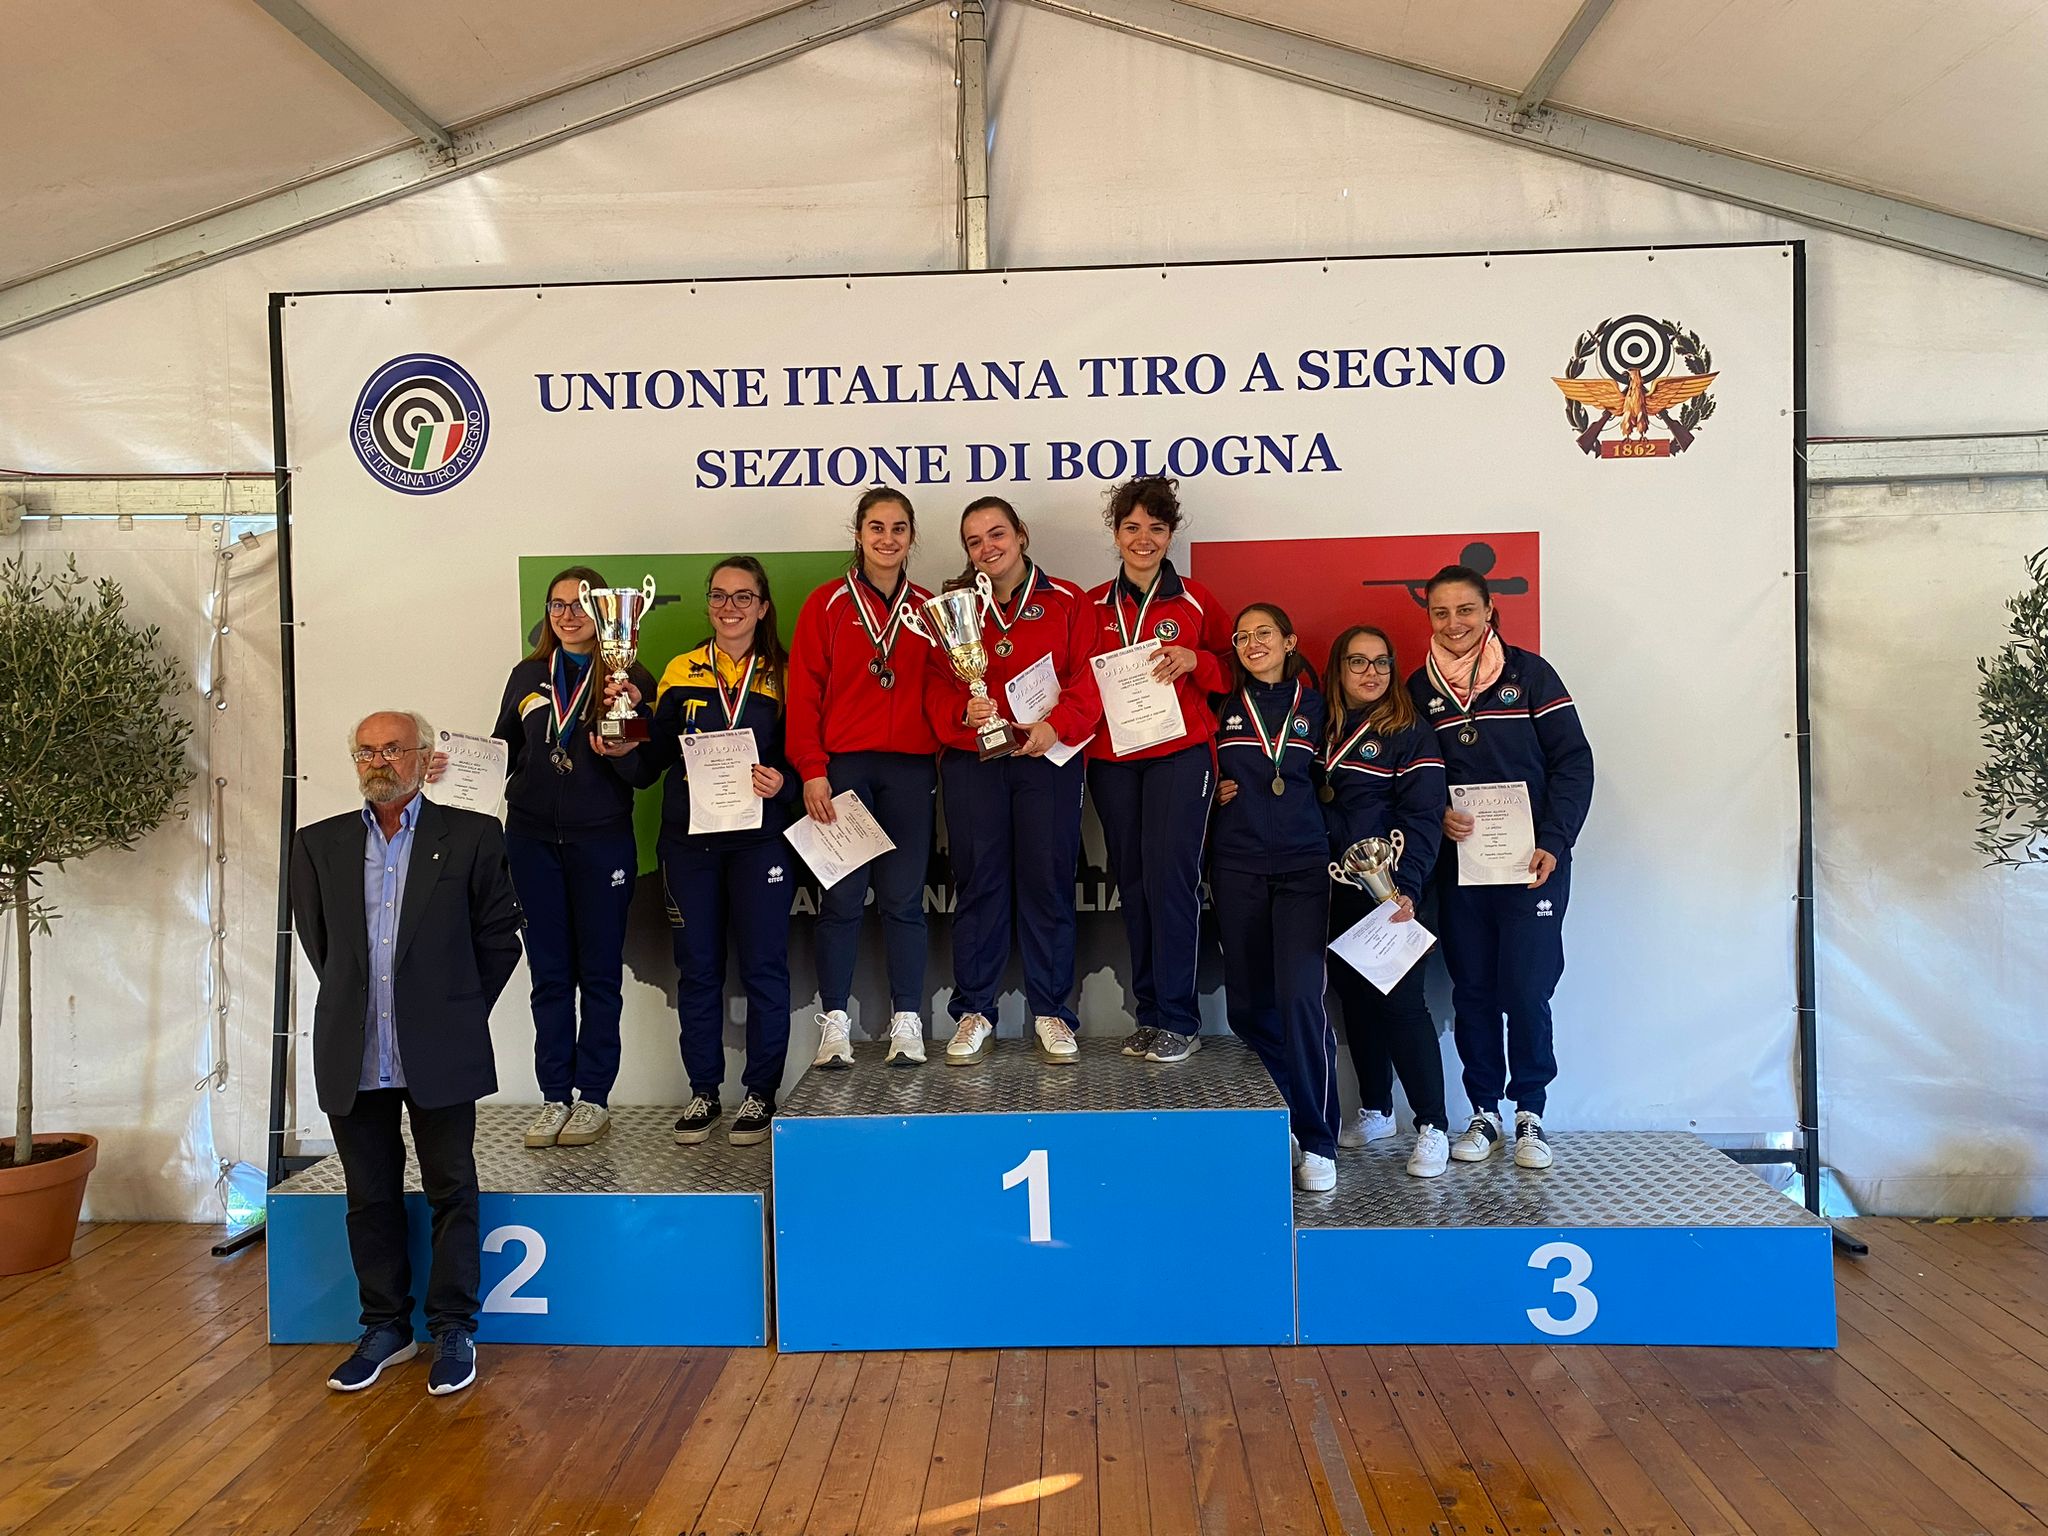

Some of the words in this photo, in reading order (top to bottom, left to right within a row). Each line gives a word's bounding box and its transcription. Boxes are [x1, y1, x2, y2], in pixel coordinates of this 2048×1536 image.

[534, 369, 767, 412] UNIONE
[783, 359, 1068, 405] ITALIANA
[1080, 354, 1225, 397] TIRO
[1240, 353, 1284, 392] A
[1298, 344, 1505, 390] SEGNO
[358, 409, 378, 458] UNIONE
[372, 456, 426, 486] ITALIANA
[426, 464, 457, 485] TIRO
[455, 457, 467, 467] A
[461, 410, 480, 458] SEGNO
[696, 446, 950, 488] SEZIONE
[966, 443, 1031, 482] DI
[1047, 433, 1342, 480] BOLOGNA
[1613, 443, 1656, 457] 1862
[446, 745, 500, 761] DIPLOMA
[693, 743, 750, 756] DIPLOMA
[1463, 796, 1522, 807] DIPLOMA
[1003, 1151, 1050, 1241] 1
[482, 1225, 548, 1314] 2
[1527, 1243, 1598, 1335] 3
